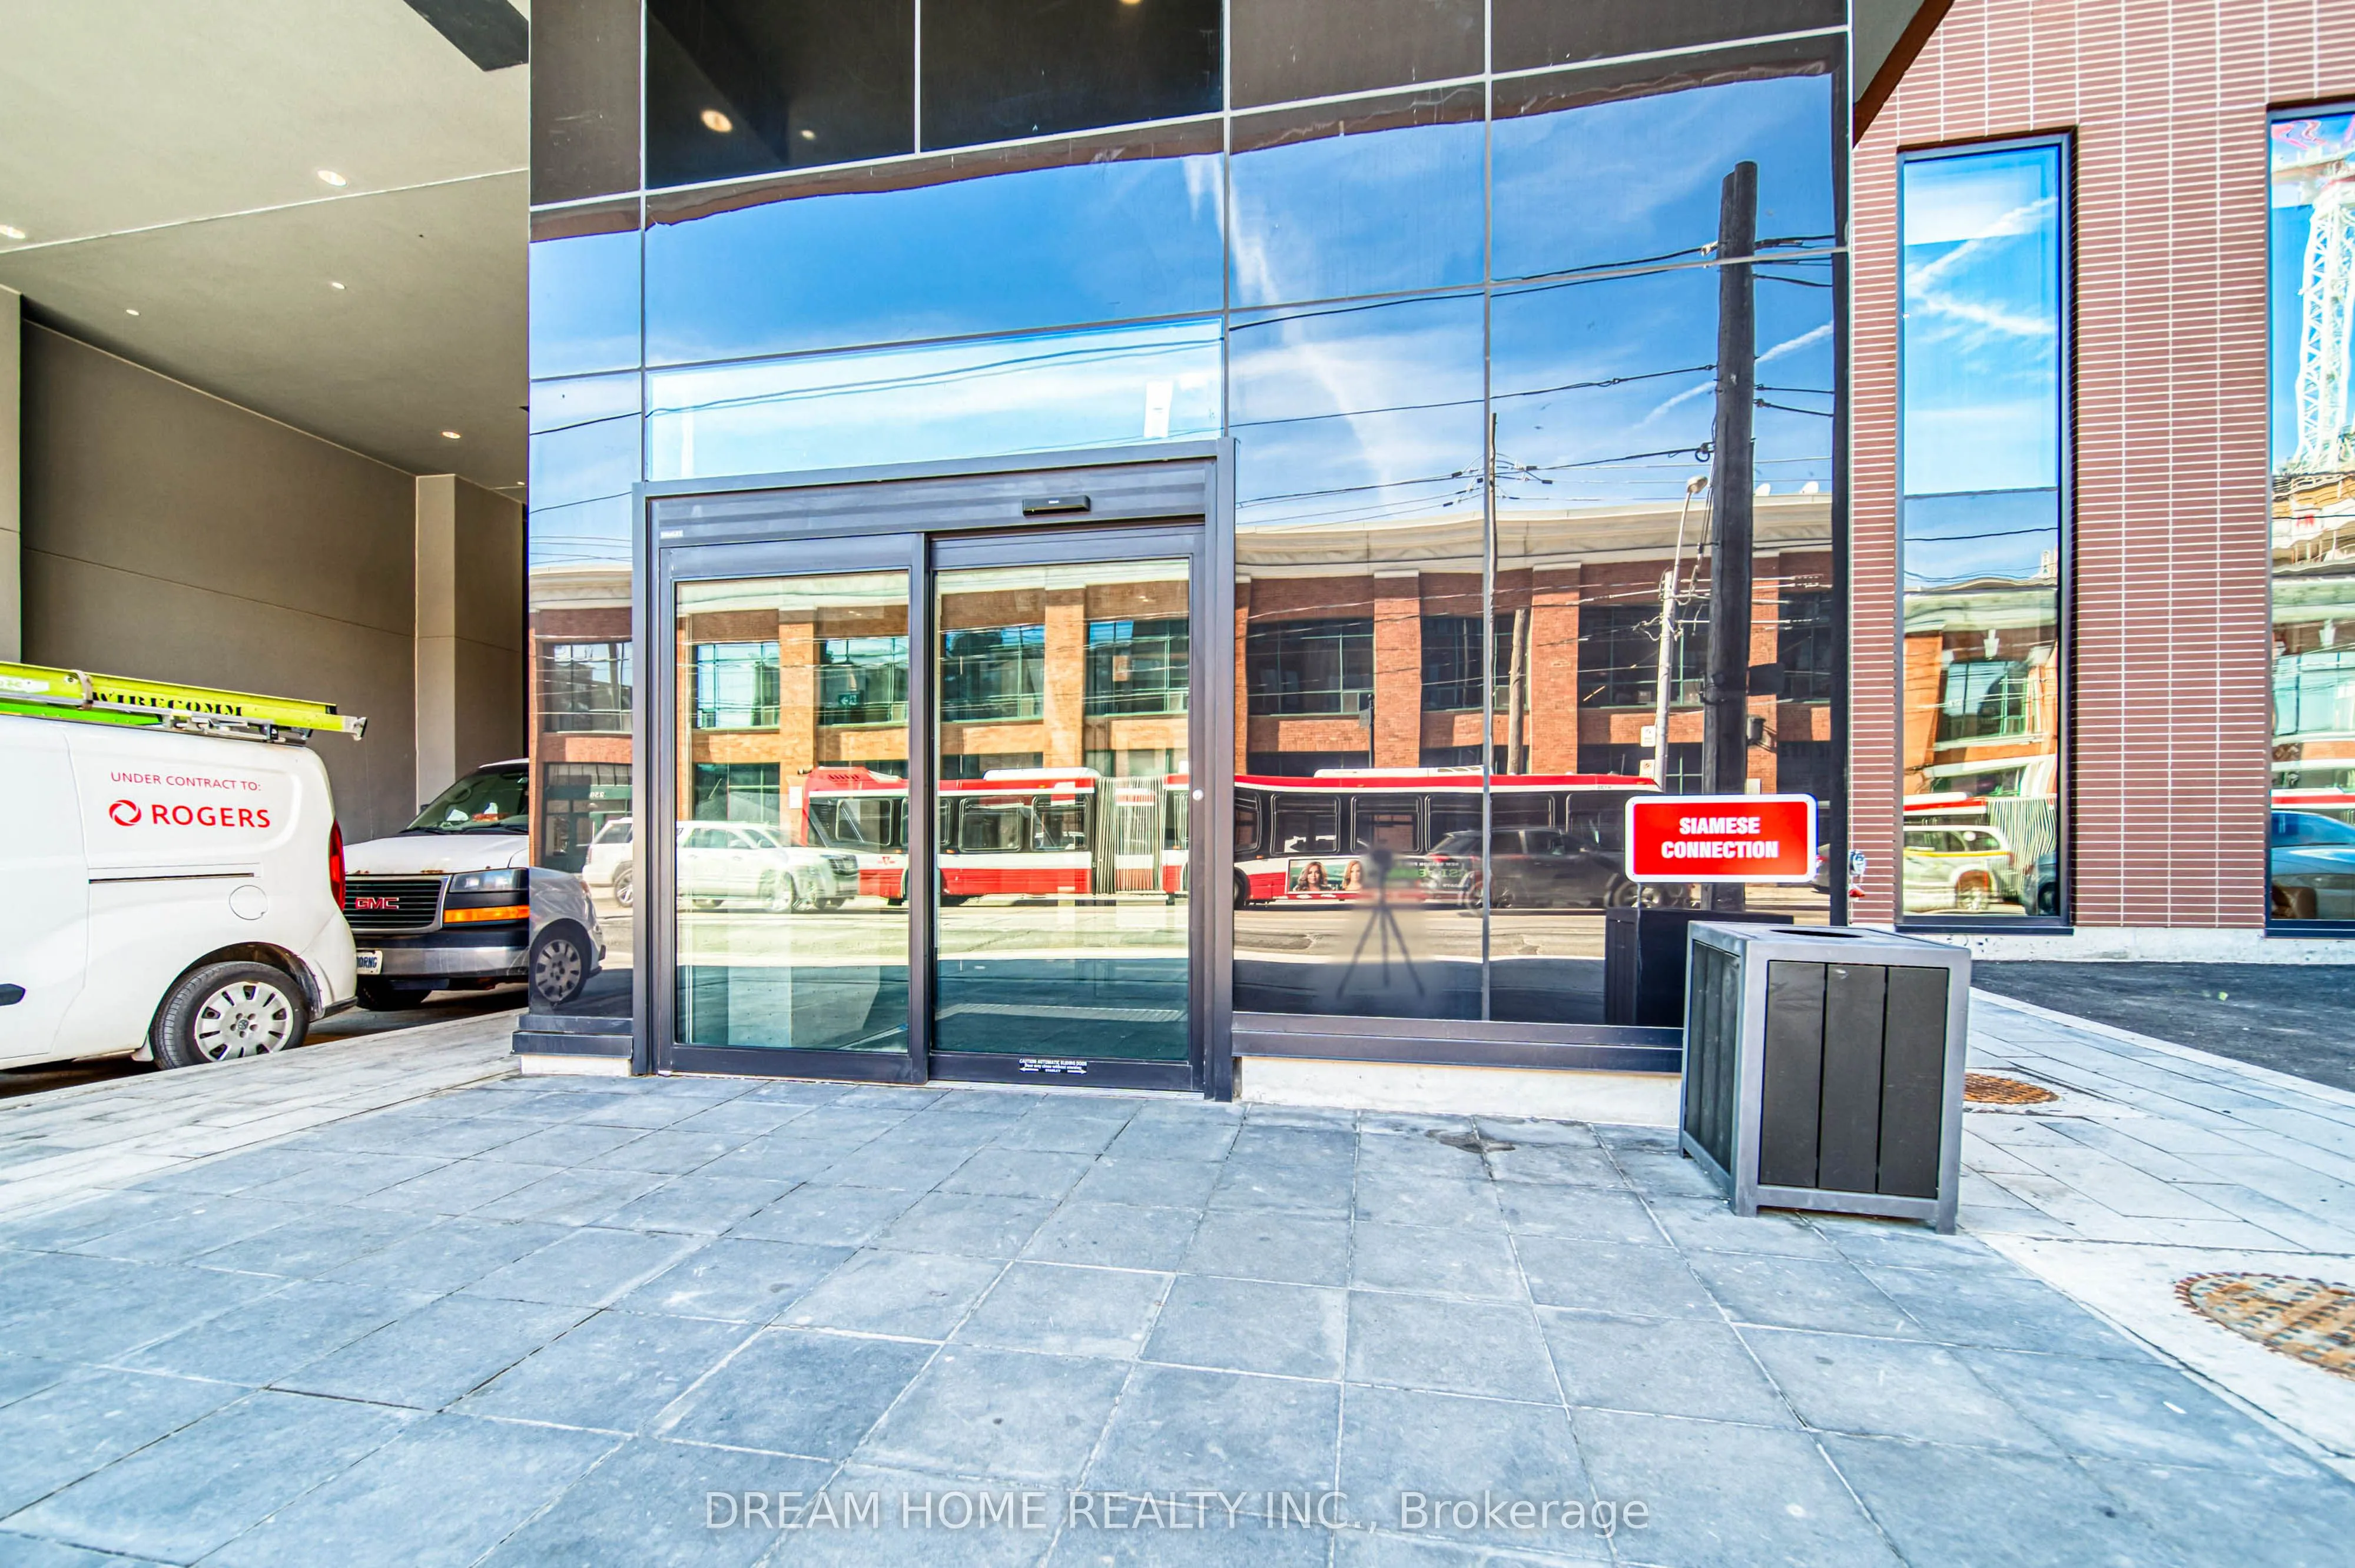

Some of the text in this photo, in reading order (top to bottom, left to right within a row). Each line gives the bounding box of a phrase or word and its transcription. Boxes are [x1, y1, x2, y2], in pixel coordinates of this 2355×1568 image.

[92, 692, 242, 716] WIRECOMM
[111, 771, 261, 792] UNDER CONTRACT TO:
[151, 804, 270, 828] ROGERS
[1679, 817, 1761, 835] SIAMESE
[1661, 841, 1779, 859] CONNECTION
[355, 896, 399, 909] GMC
